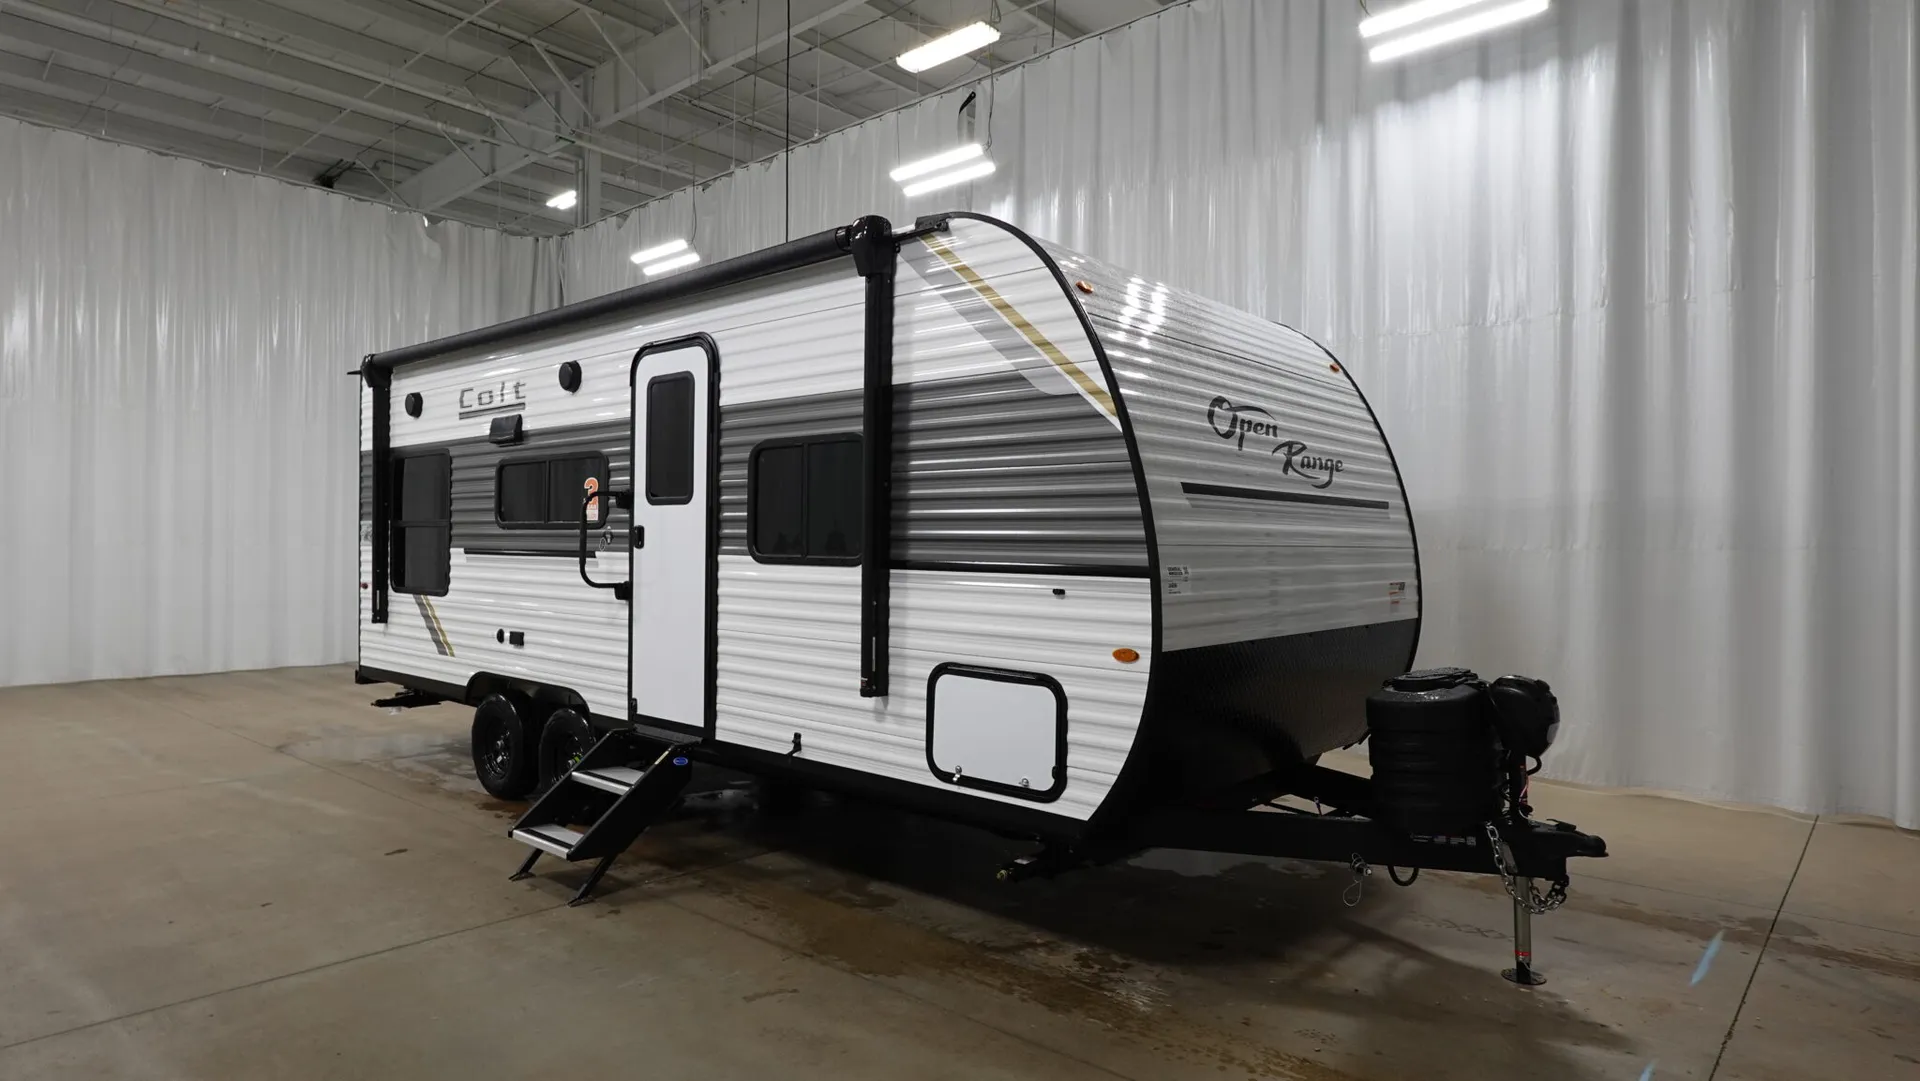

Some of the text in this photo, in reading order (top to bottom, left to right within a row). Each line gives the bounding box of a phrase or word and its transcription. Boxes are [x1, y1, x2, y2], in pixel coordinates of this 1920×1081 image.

[459, 381, 526, 409] Colt
[1207, 396, 1278, 451] Open
[1271, 440, 1344, 489] Range
